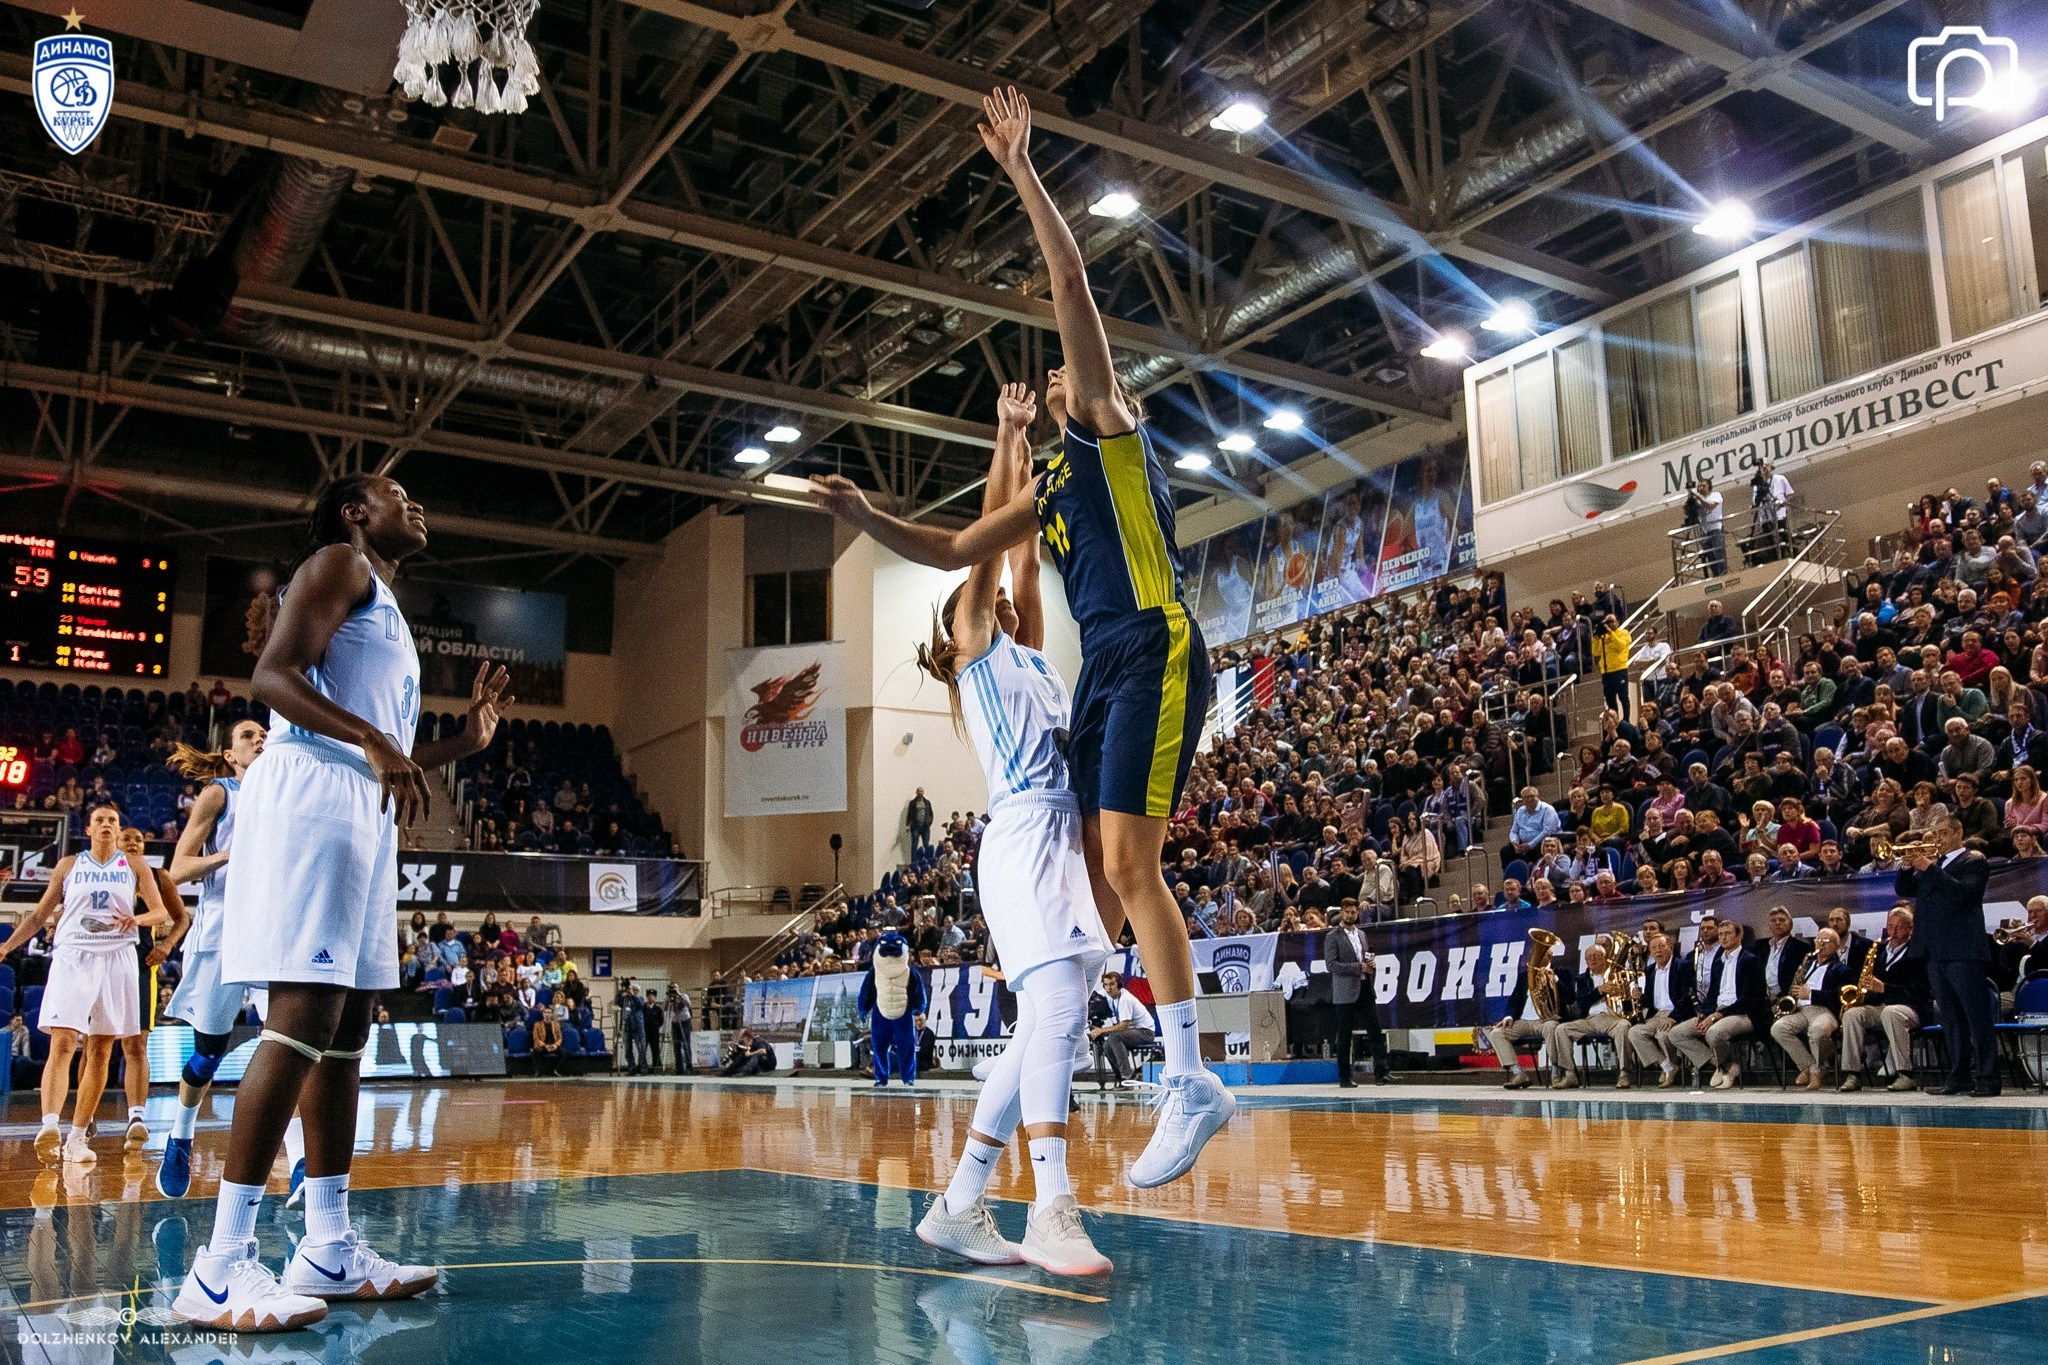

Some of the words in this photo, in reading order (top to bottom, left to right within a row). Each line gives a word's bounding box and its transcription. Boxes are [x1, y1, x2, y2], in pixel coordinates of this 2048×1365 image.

[1701, 422, 1758, 449] генеральный
[1758, 411, 1793, 430] спонсор
[1795, 385, 1866, 417] баскетбольного
[1866, 374, 1895, 397] клуба
[1943, 349, 1974, 368] Курск
[1662, 358, 2004, 496] Металлоинвест
[30, 547, 55, 559] TUR
[14, 565, 50, 588] 59
[437, 641, 526, 661] ОБЛАСТИ
[75, 871, 128, 884] DYNAMO
[90, 890, 110, 910] 12
[1214, 947, 1250, 965] ДИНАМО
